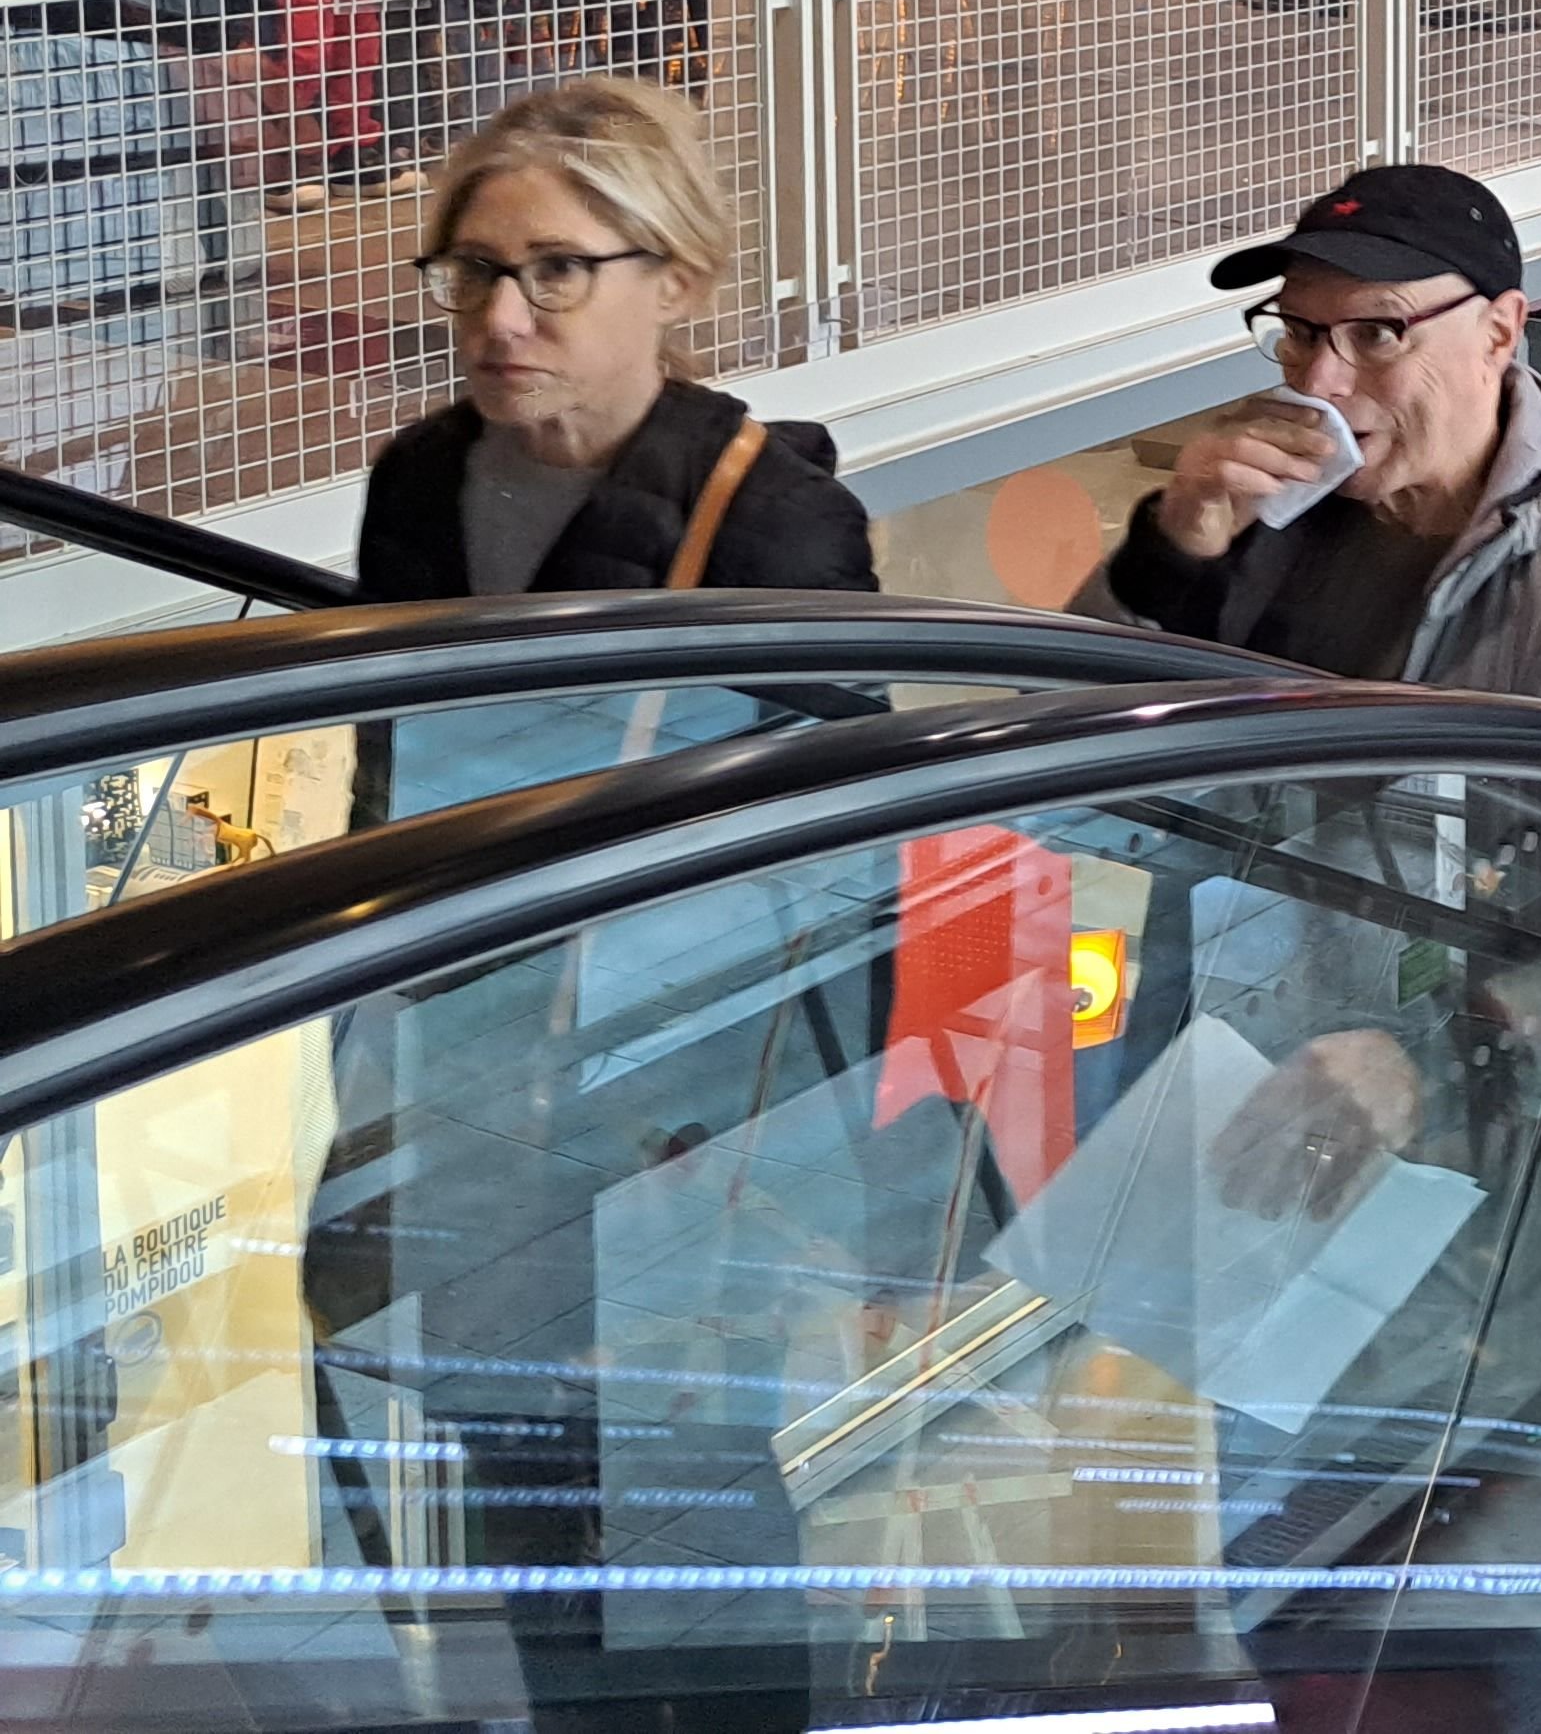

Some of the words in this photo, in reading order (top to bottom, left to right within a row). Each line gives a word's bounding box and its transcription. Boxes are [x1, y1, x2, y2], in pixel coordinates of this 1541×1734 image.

[103, 1244, 127, 1273] LA
[133, 1194, 226, 1259] BOUTIQUE
[104, 1265, 128, 1297] DU
[136, 1227, 208, 1281] CENTRE
[104, 1253, 205, 1322] POMPIDOU
